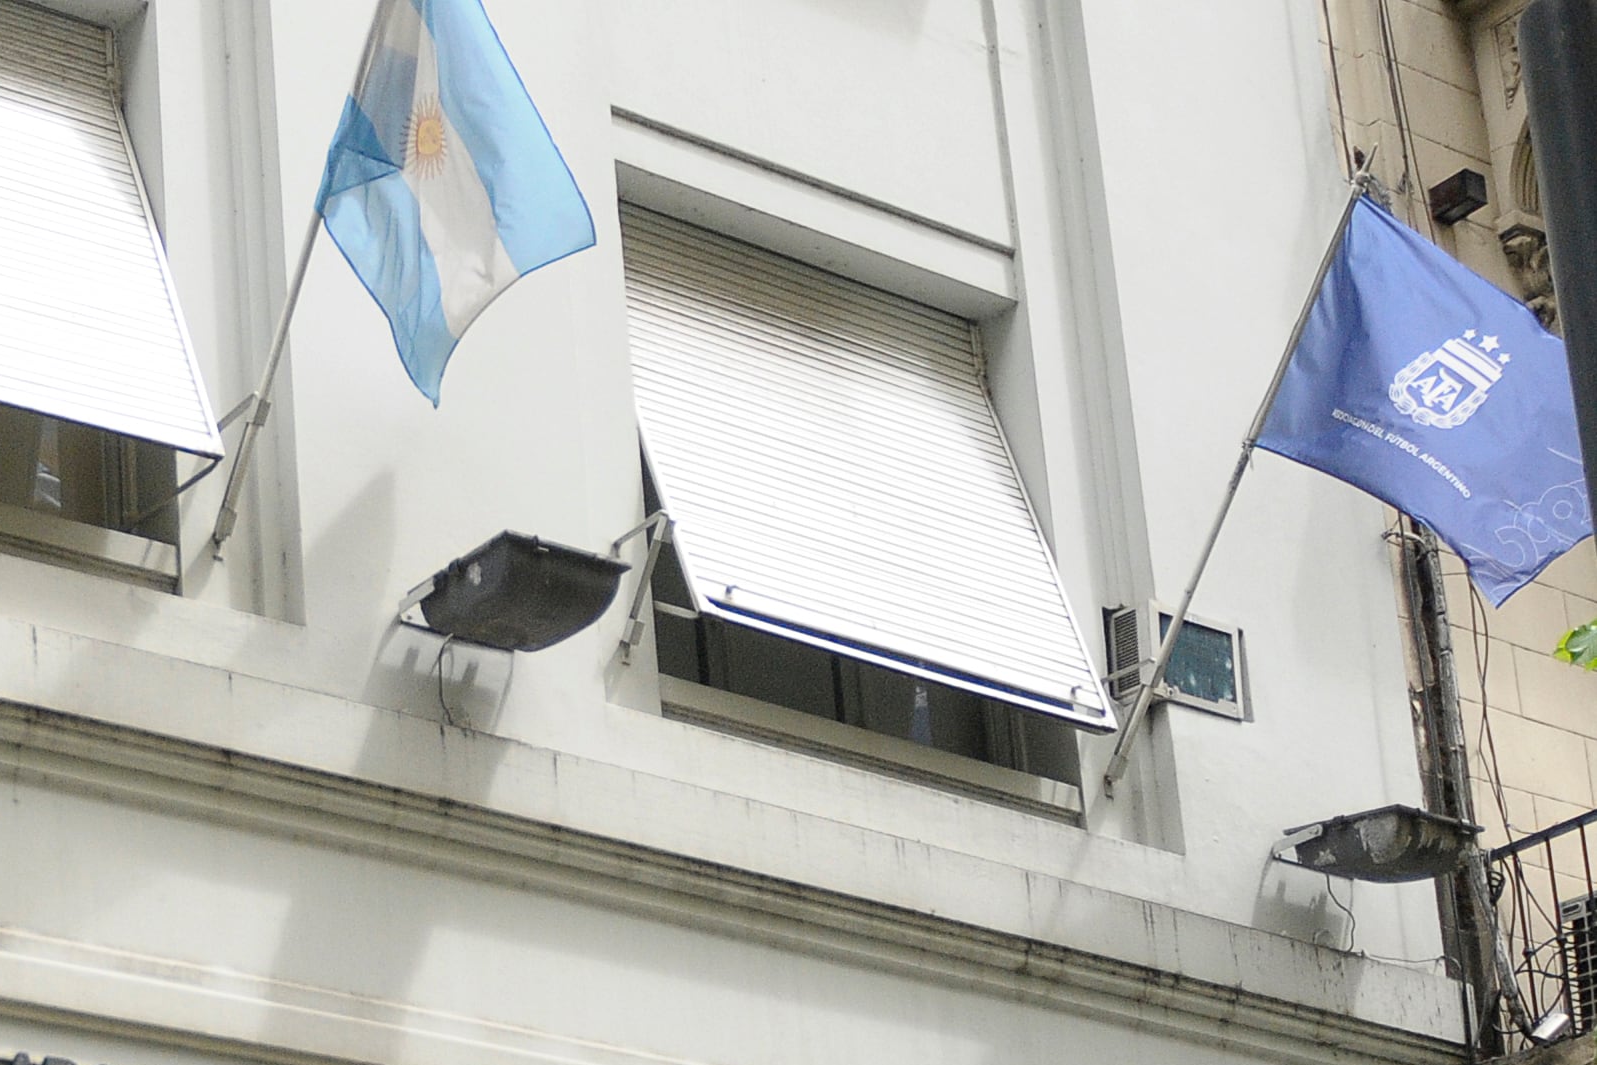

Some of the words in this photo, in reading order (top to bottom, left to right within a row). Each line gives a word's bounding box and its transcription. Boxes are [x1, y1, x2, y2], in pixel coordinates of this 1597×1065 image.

[1409, 367, 1463, 412] AFA
[1367, 424, 1385, 438] DEL
[1385, 434, 1420, 456] FÚTBOL
[1420, 453, 1471, 498] ARGENTINO
